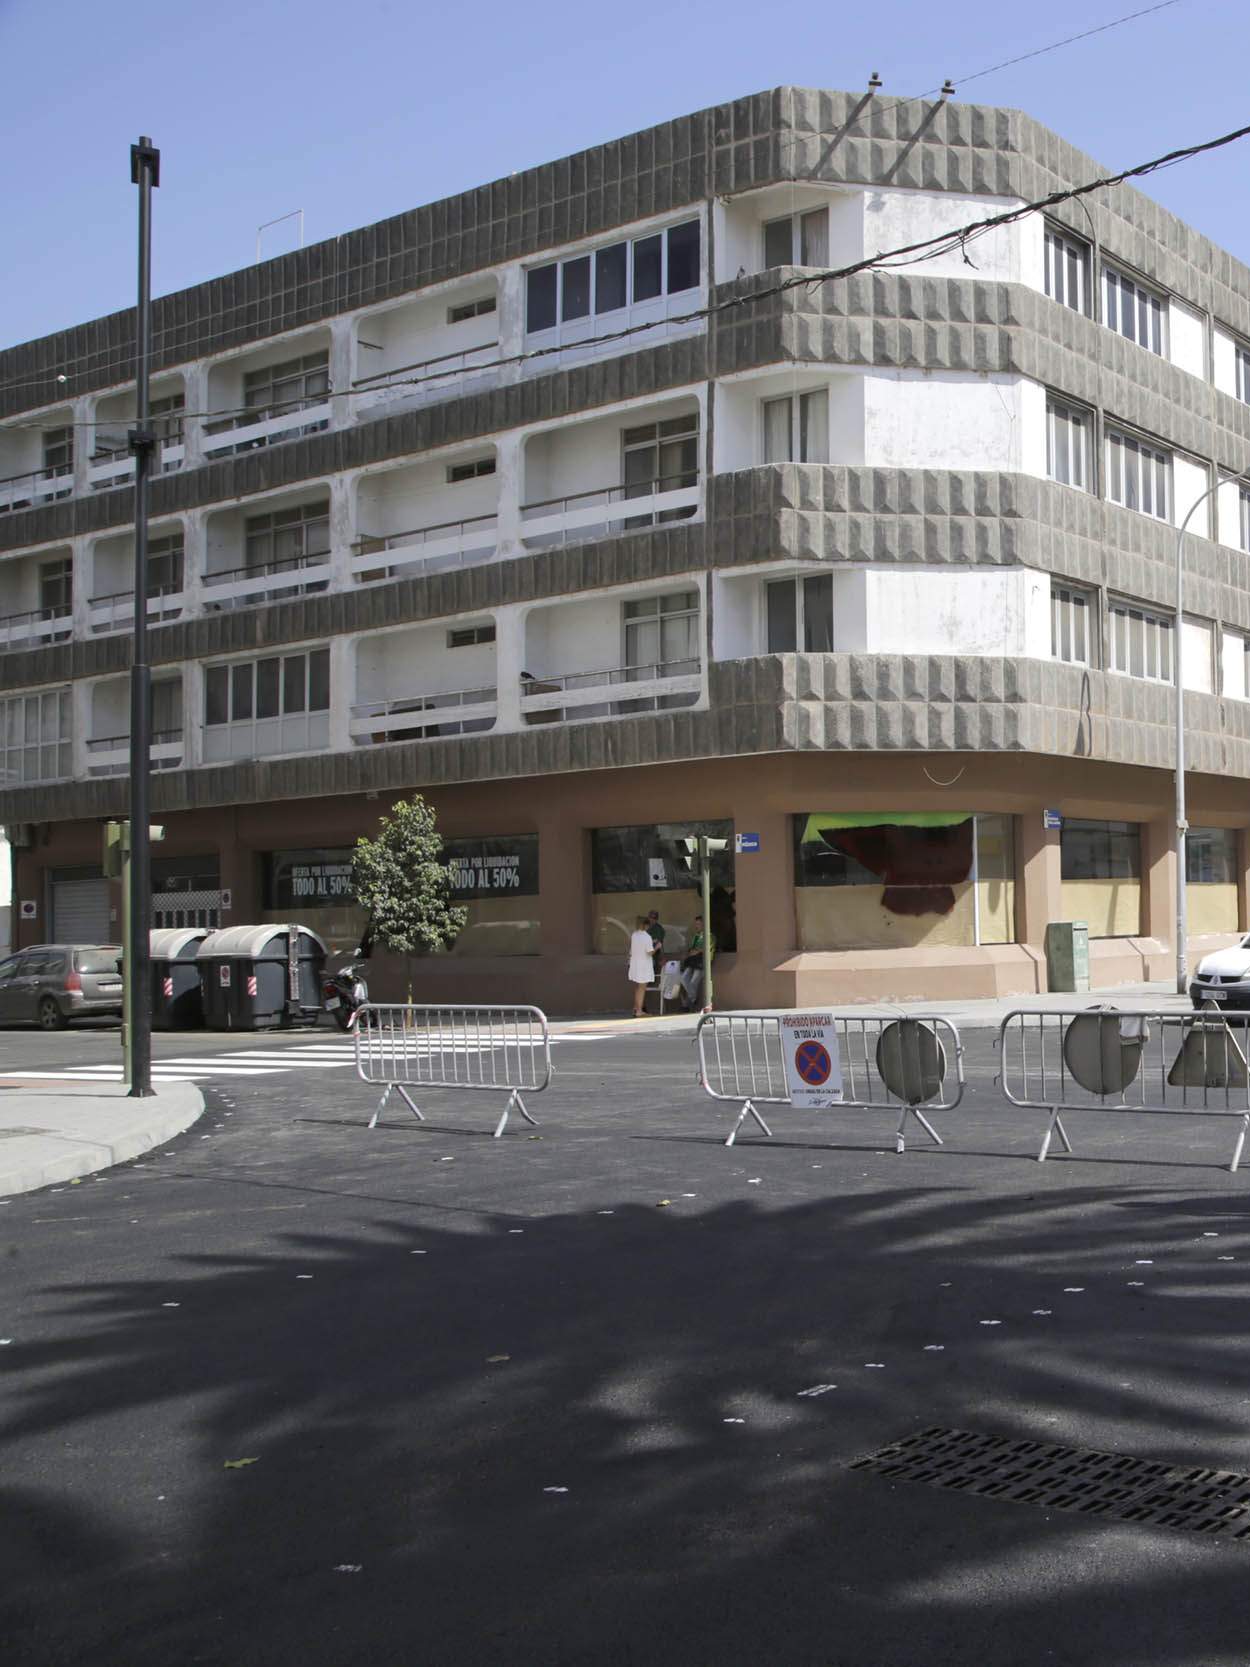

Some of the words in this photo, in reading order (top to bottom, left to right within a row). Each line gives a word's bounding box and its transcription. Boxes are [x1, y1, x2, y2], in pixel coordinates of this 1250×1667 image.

[471, 857, 483, 868] POR
[292, 877, 314, 896] TODO
[317, 876, 328, 895] AL
[478, 868, 490, 888] AL
[493, 867, 520, 888] 50%
